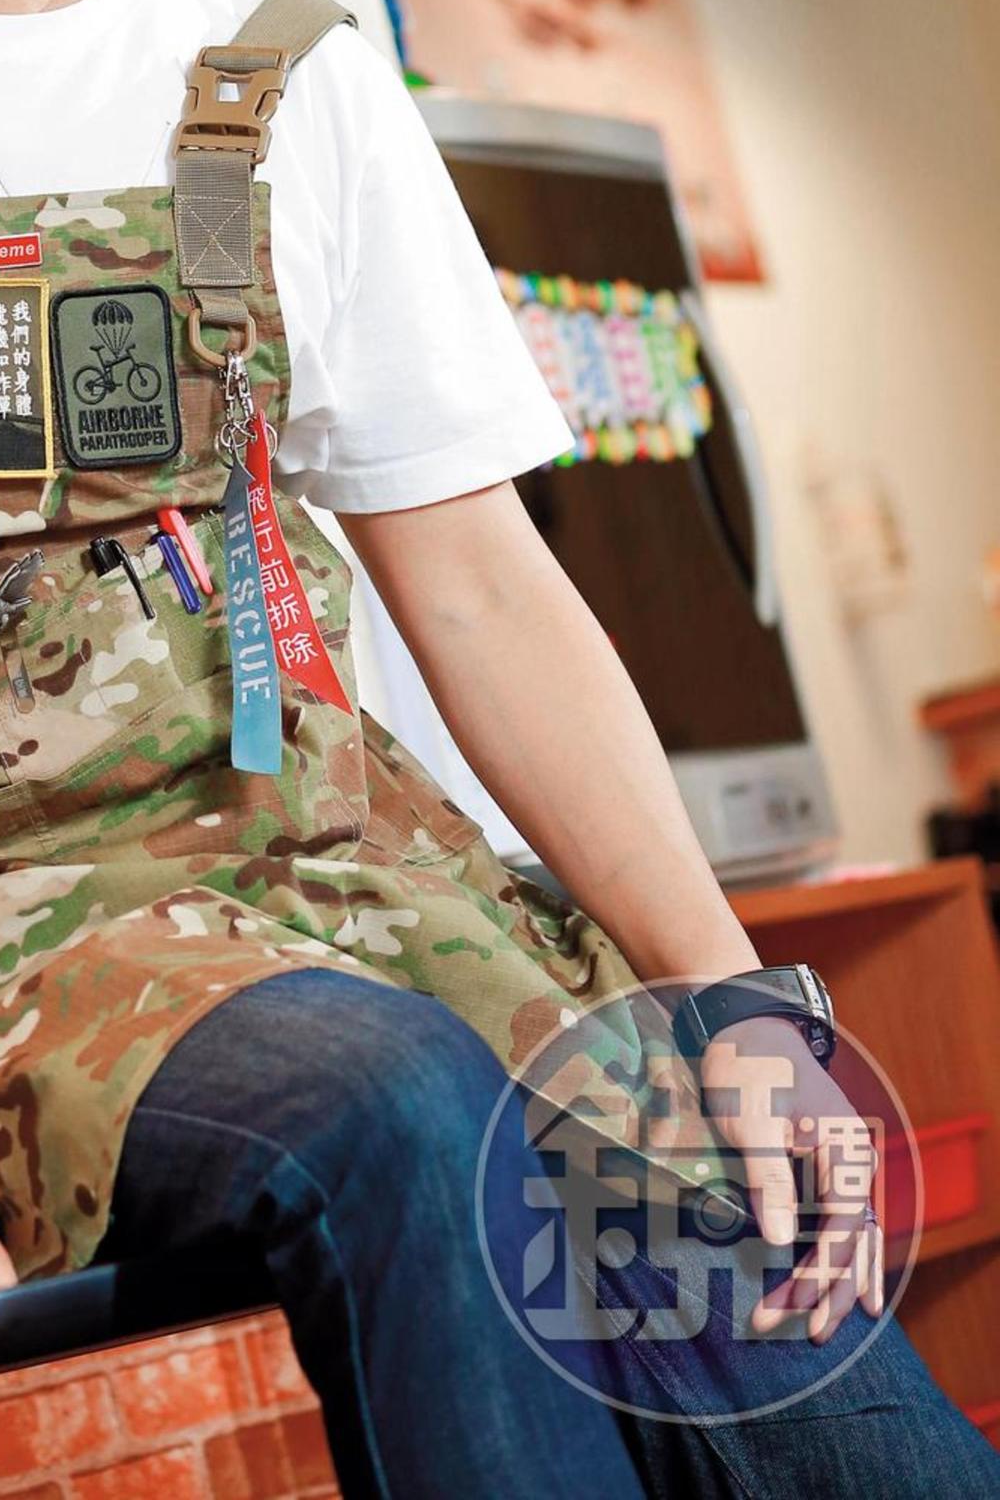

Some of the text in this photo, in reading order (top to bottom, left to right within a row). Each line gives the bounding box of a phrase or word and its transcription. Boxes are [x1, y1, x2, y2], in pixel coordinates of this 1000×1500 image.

[10, 299, 33, 417] 我們的身體
[78, 404, 167, 434] AIRBORNE
[80, 430, 169, 451] PARATROOPER
[227, 511, 272, 706] RESCUE
